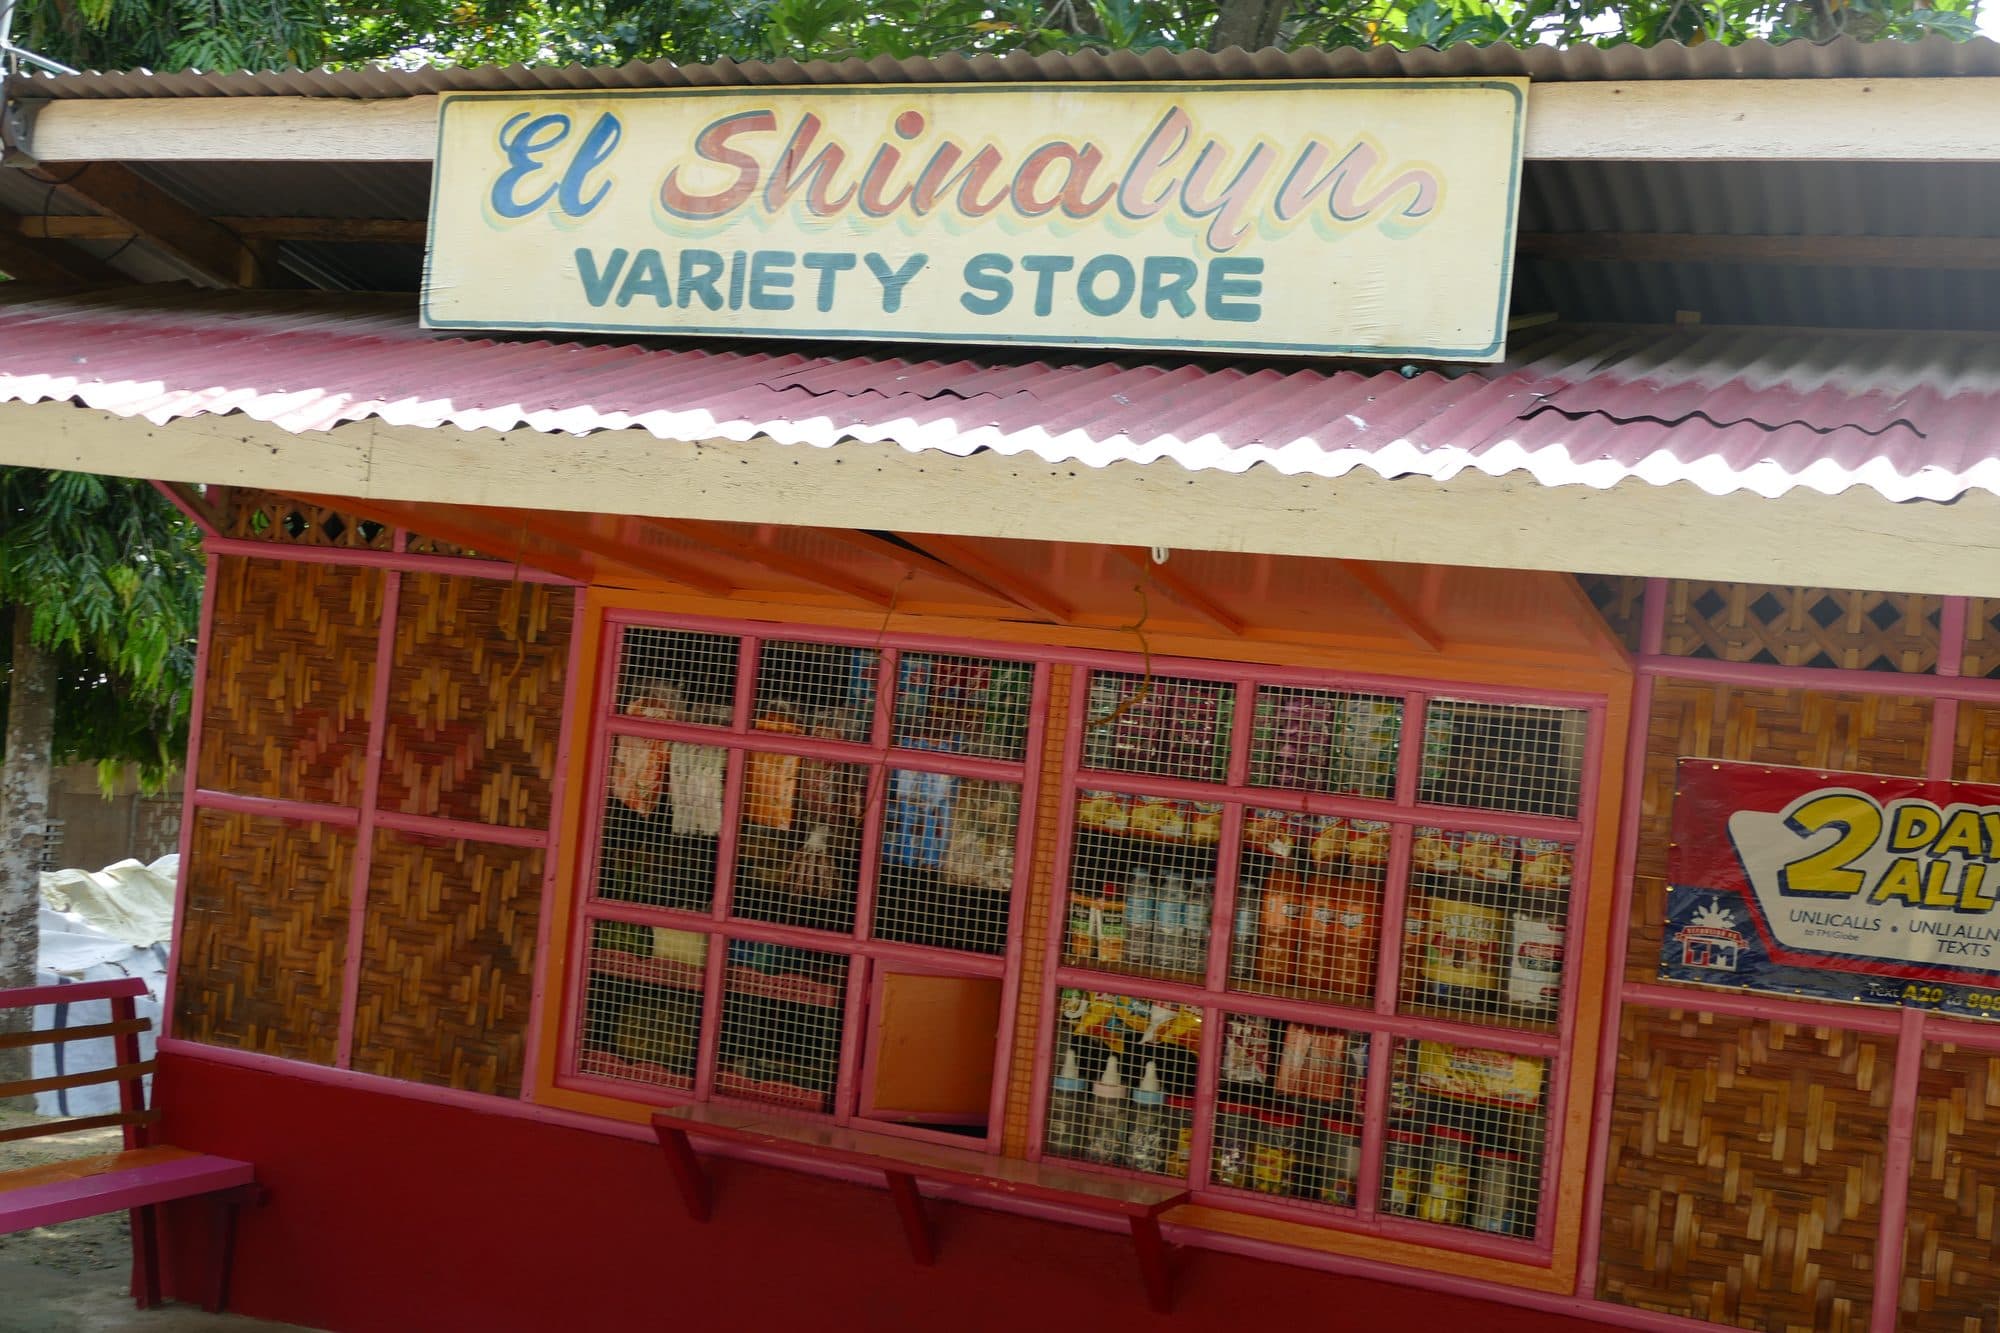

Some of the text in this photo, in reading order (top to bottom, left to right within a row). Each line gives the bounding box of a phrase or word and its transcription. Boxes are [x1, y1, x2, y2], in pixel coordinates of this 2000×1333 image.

[491, 104, 1438, 254] El Shinalyn
[573, 247, 1265, 323] VARIETY STORE
[1776, 792, 1883, 900] 2
[1789, 908, 1882, 932] UNLICALLS
[1908, 919, 1951, 937] UNLI
[1686, 940, 1736, 968] TM
[1937, 938, 1992, 957] TEXTS
[1901, 984, 1944, 1003] A20
